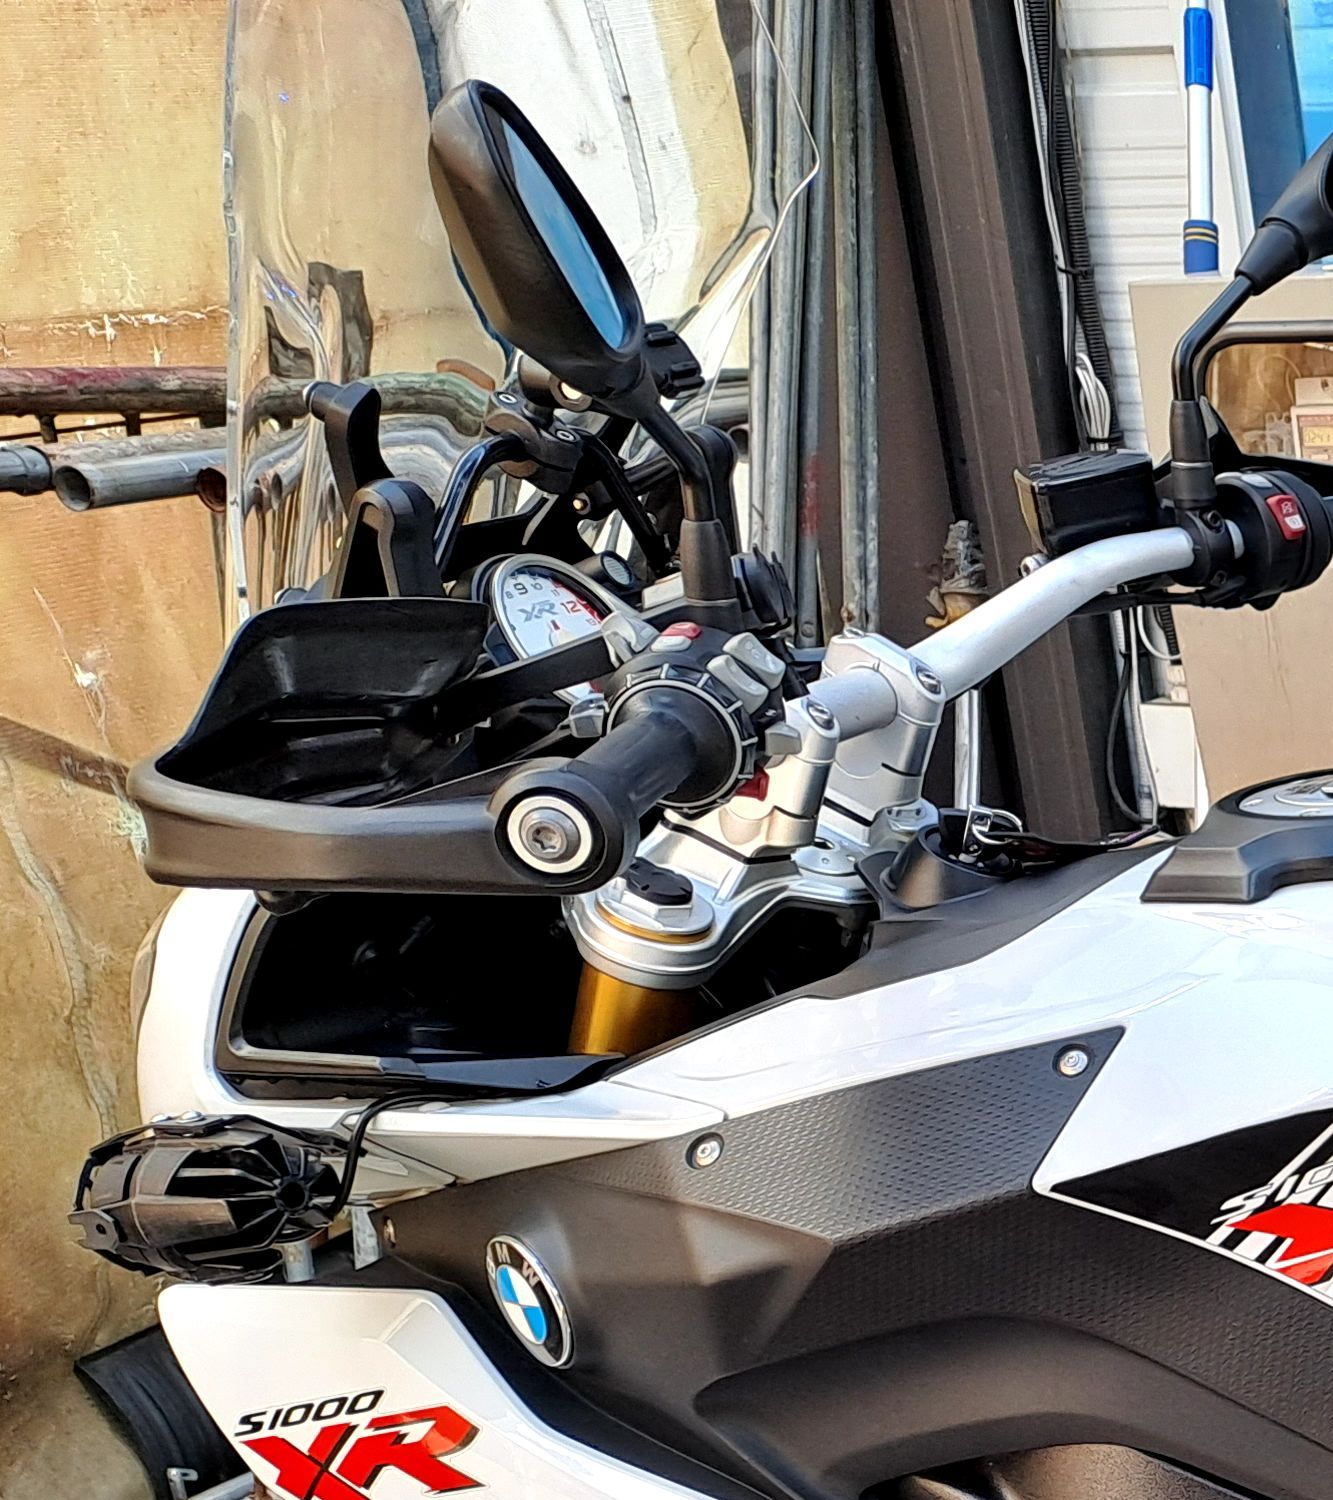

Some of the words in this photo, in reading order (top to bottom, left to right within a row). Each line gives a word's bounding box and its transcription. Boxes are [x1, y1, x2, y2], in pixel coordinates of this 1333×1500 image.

[517, 600, 560, 623] XR
[560, 600, 582, 615] 12
[234, 1389, 385, 1438] S1000
